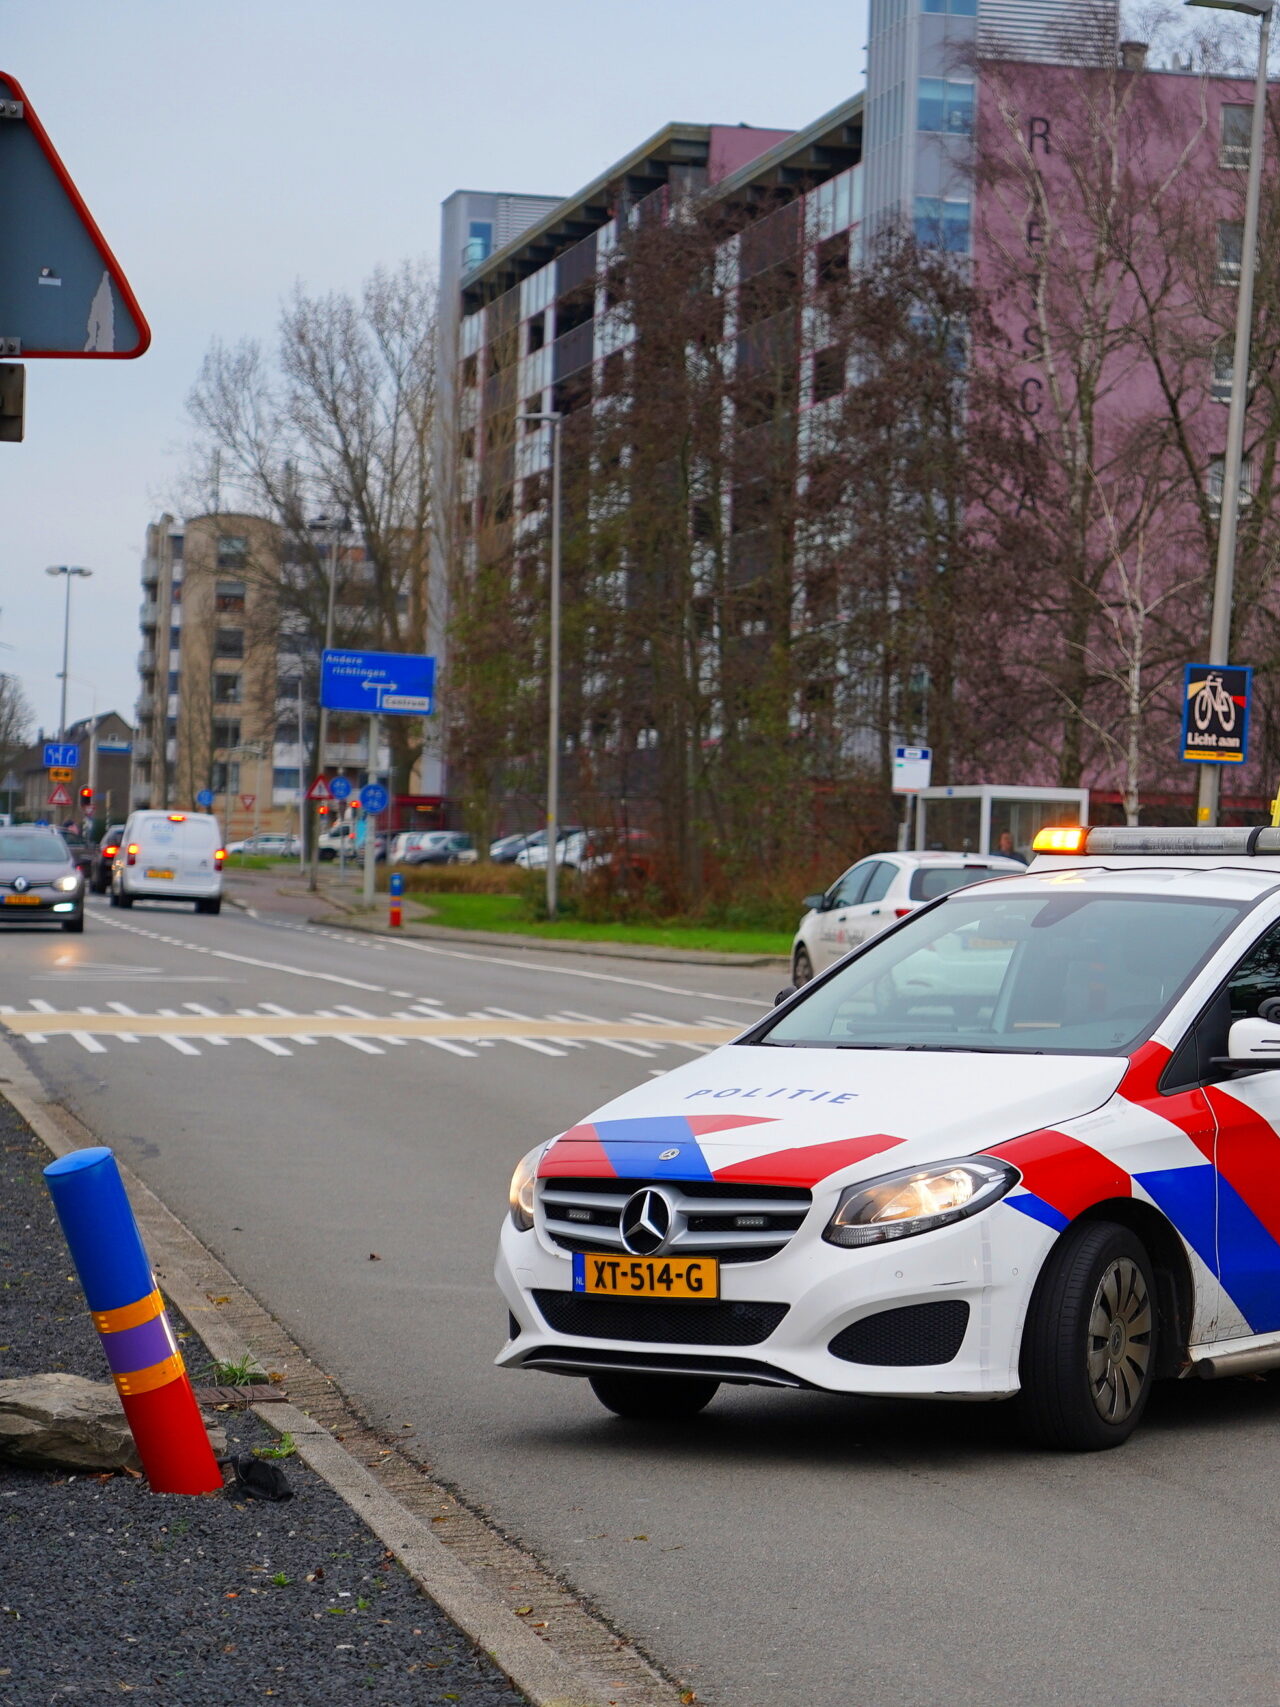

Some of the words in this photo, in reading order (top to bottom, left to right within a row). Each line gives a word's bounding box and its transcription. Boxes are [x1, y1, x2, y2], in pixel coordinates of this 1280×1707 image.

[332, 666, 386, 678] richtingen
[1187, 732, 1217, 747] Licht
[683, 1087, 860, 1104] POLITIE
[575, 1276, 584, 1286] NL
[593, 1260, 704, 1292] XT-514-G
